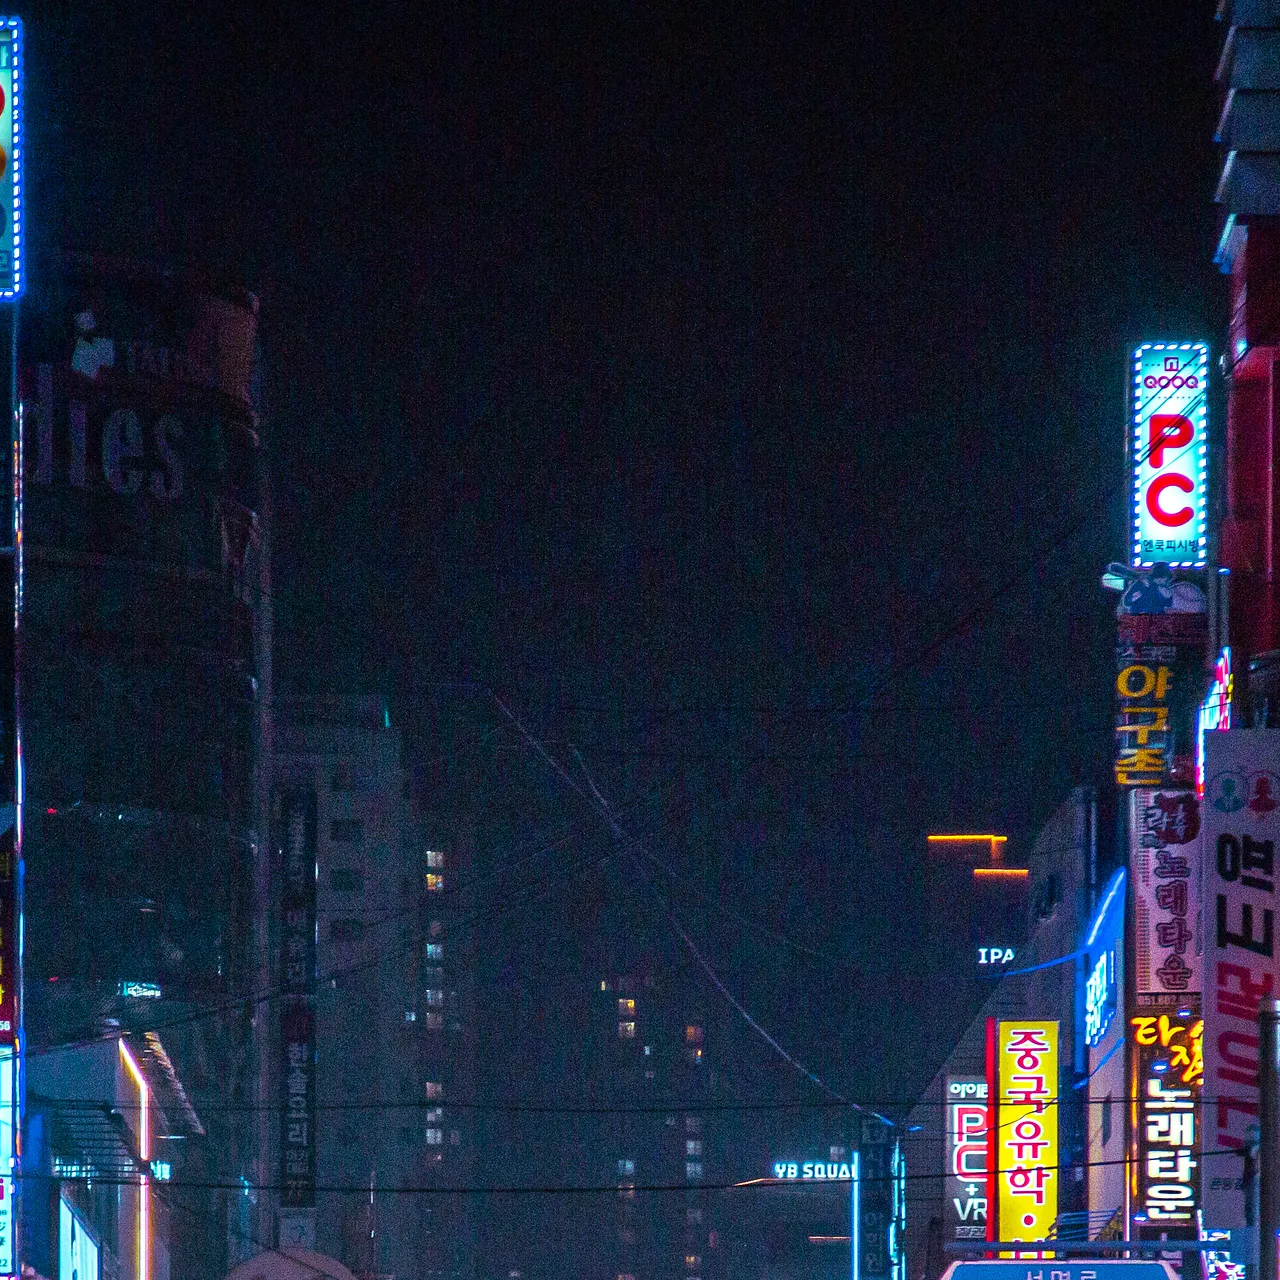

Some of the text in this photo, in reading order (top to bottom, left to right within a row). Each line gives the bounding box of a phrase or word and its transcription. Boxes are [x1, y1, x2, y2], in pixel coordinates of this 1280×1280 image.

[1146, 414, 1195, 527] PC
[775, 1163, 798, 1178] YB
[1006, 1031, 1053, 1205] 중국유학
[1145, 1080, 1196, 1219] 노래타운
